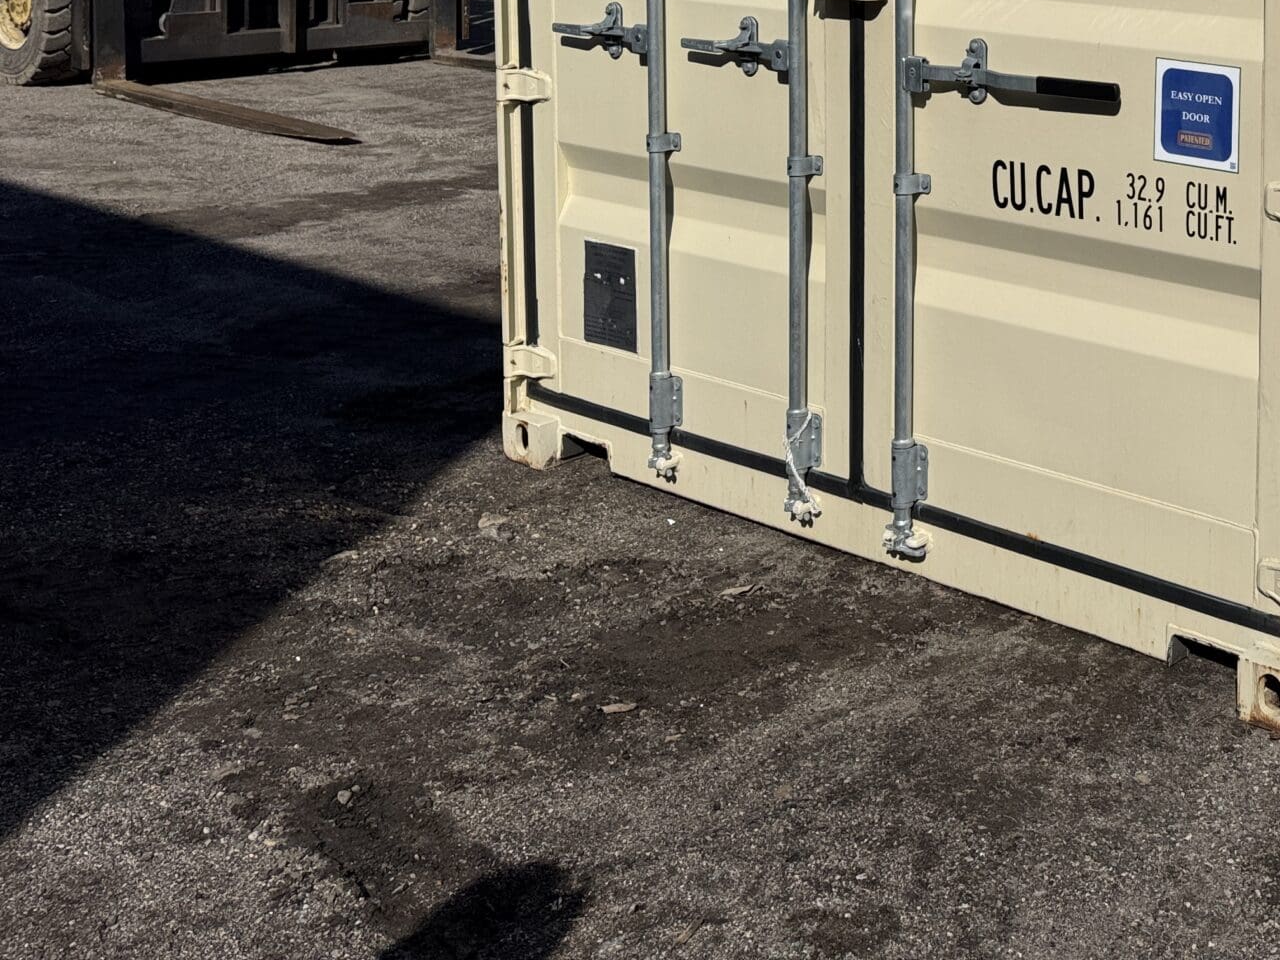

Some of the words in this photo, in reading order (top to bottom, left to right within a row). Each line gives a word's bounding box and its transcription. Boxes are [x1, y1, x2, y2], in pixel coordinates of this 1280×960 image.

[1170, 90, 1194, 101] EASY
[1195, 94, 1222, 106] OPEN
[1182, 111, 1210, 123] DOOR
[992, 159, 1101, 222] CU.CAP.
[1126, 173, 1165, 203] 32.9
[1116, 200, 1164, 232] 1,161
[1186, 210, 1238, 245] CU.FT.
